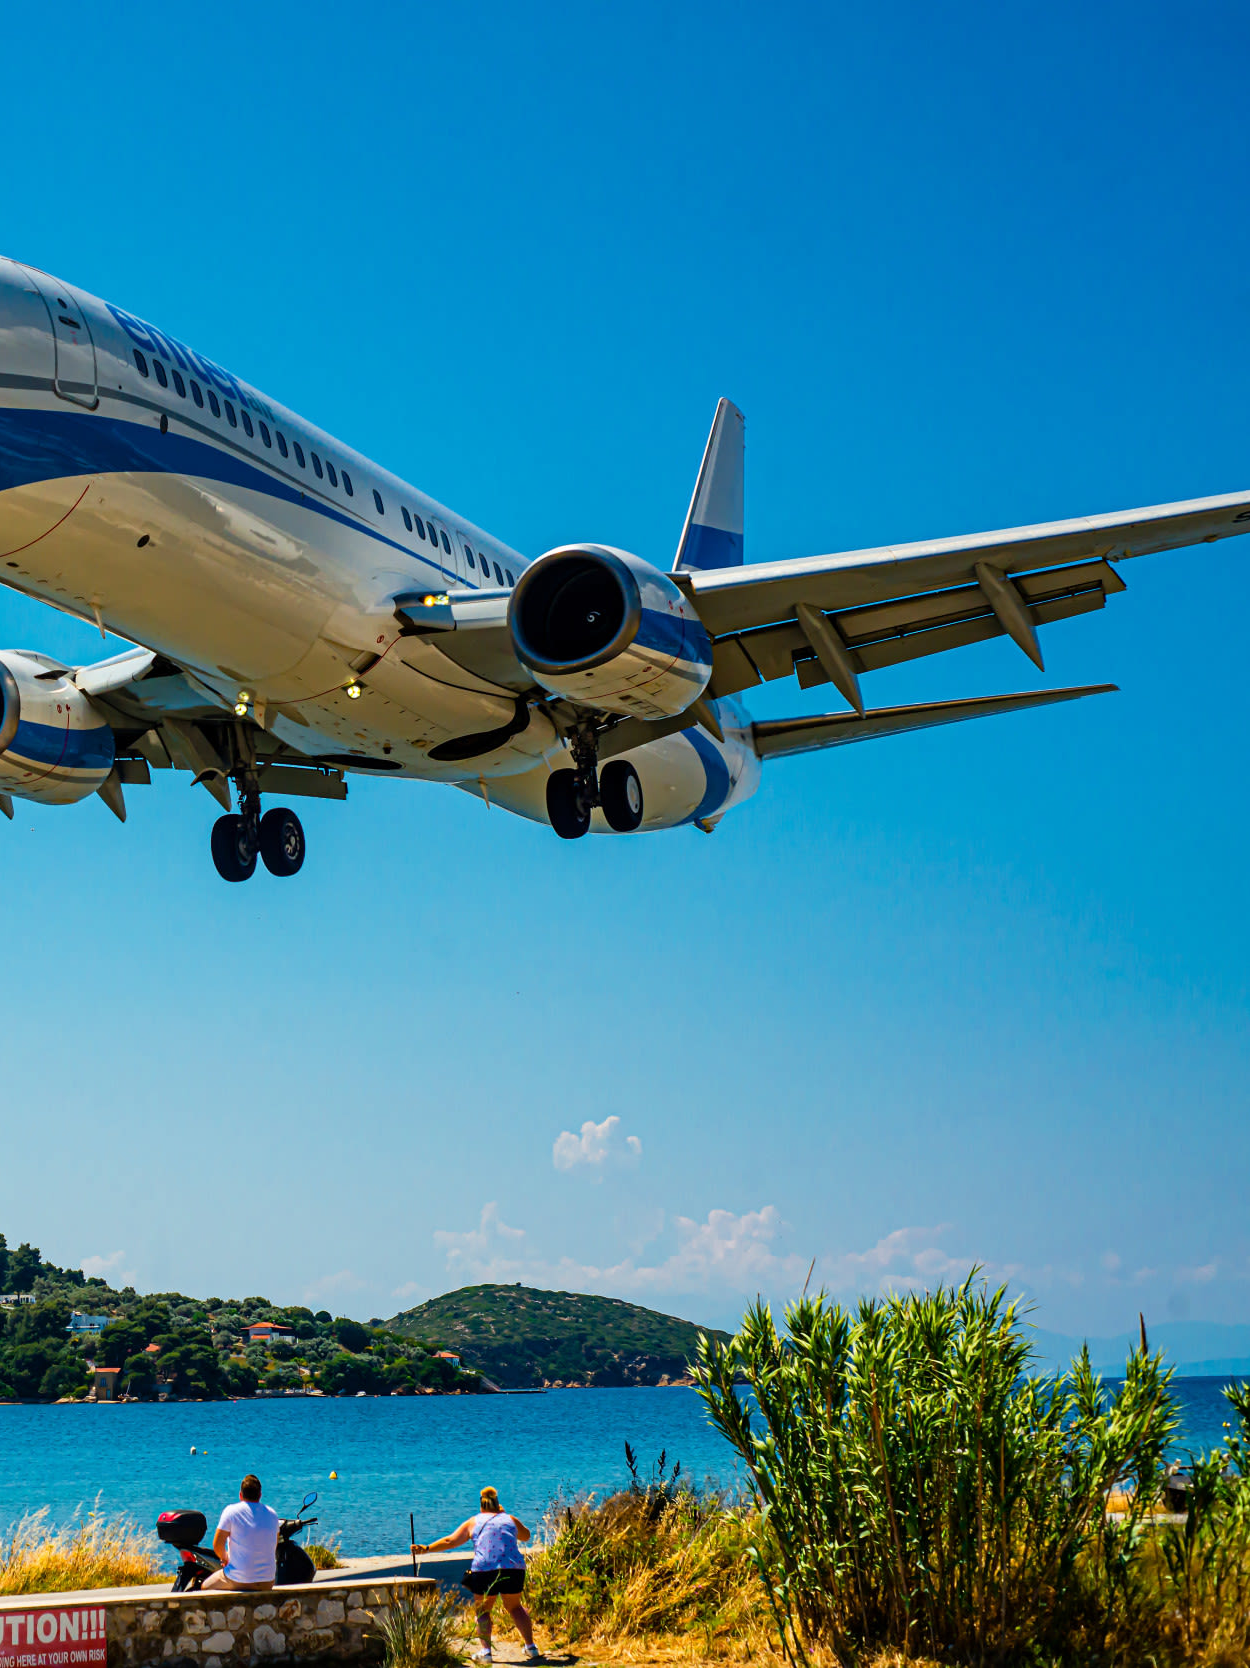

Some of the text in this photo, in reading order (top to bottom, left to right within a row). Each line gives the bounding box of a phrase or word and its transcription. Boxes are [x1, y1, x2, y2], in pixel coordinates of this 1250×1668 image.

[16, 1654, 37, 1668] HERE
[38, 1653, 47, 1666] AT
[48, 1651, 69, 1665] YOUR
[70, 1649, 88, 1663] OWN
[88, 1648, 105, 1661] RISK
